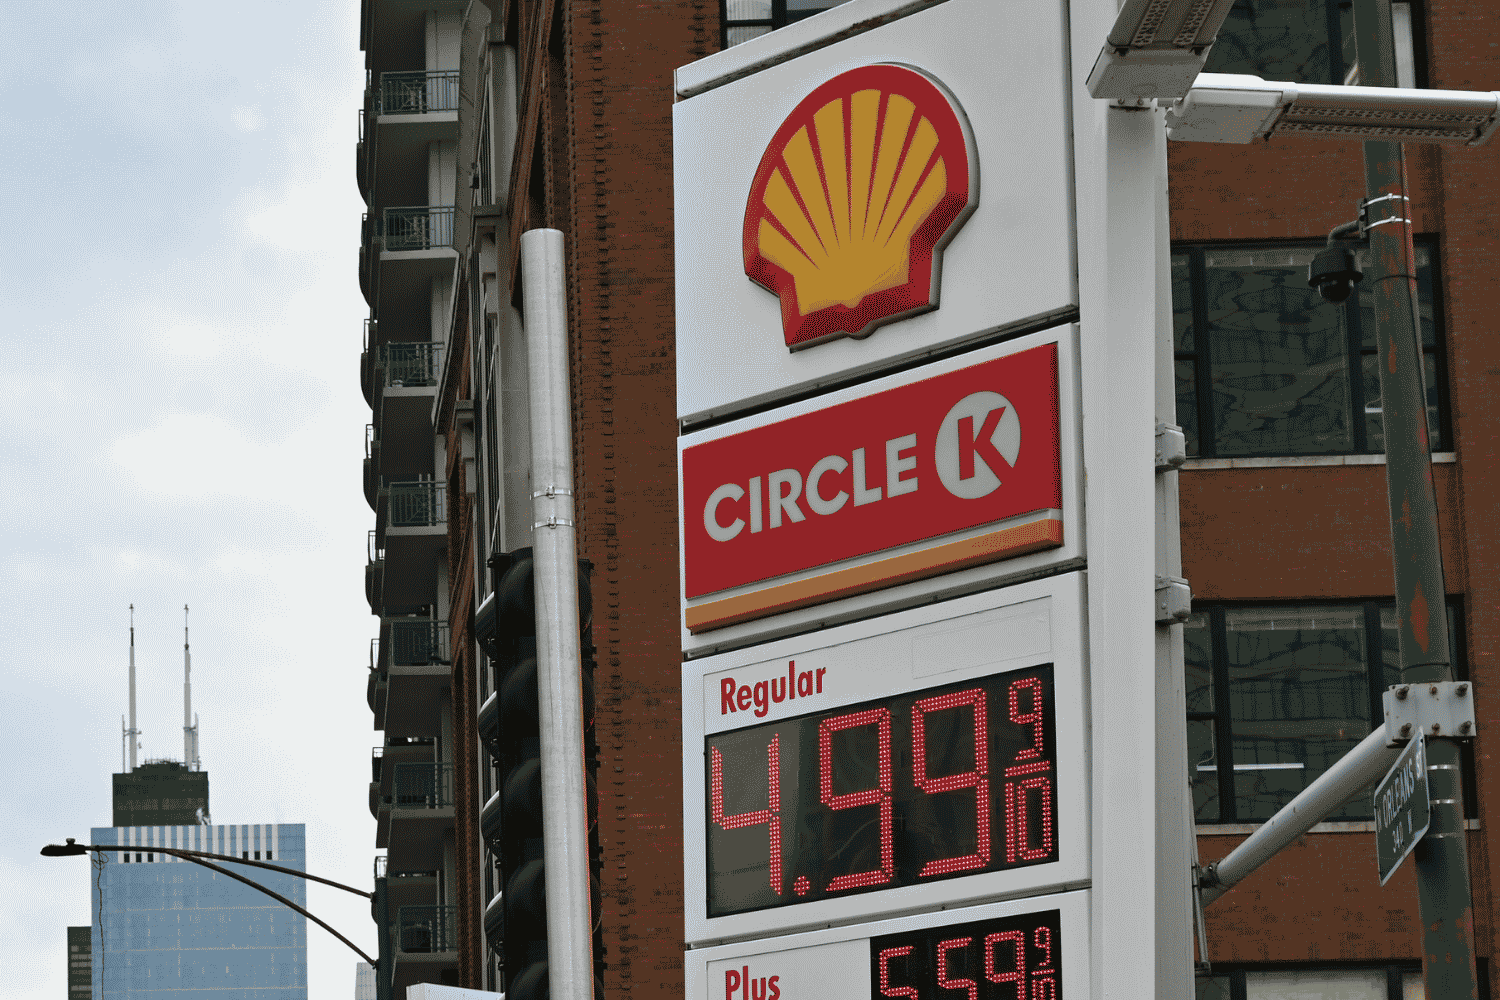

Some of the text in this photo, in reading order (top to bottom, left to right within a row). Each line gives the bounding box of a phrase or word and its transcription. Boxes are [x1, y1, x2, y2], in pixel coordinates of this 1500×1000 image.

[703, 396, 1019, 542] CIRCLE K
[720, 661, 826, 718] Regular
[711, 687, 991, 896] 4.99
